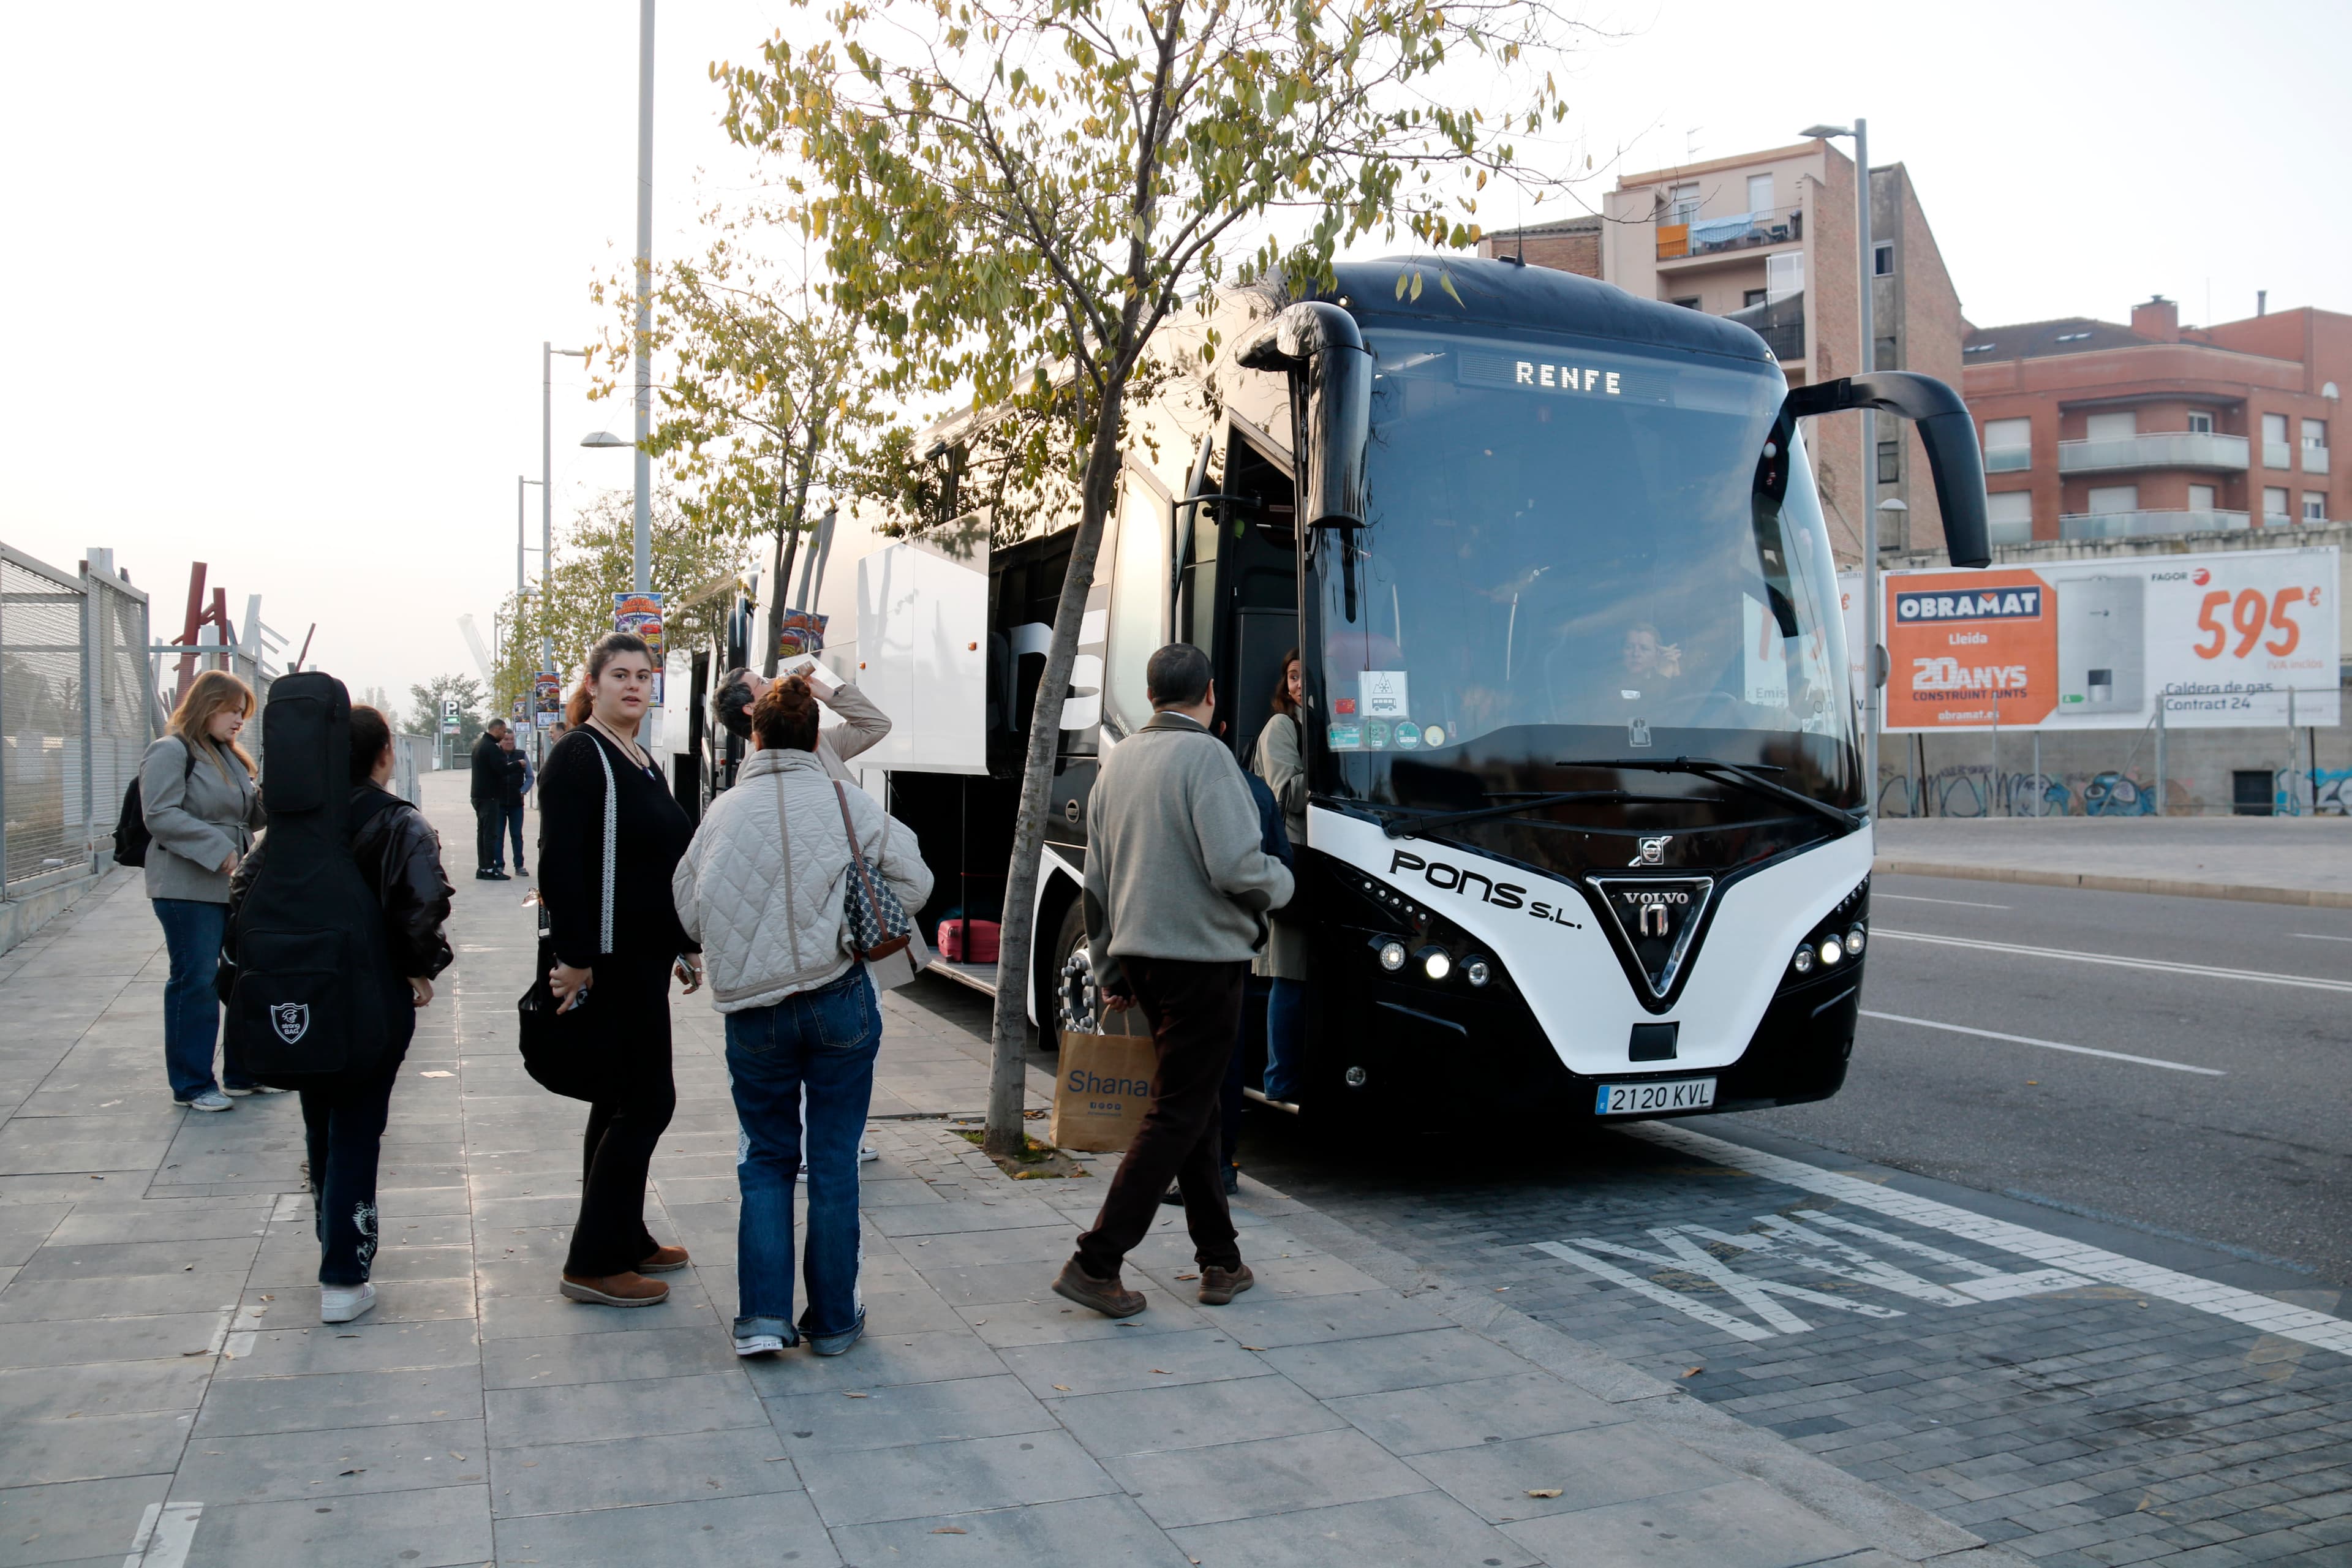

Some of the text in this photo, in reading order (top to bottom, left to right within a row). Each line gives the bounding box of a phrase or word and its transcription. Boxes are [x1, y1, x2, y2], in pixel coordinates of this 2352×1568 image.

[1517, 361, 1621, 394] RENFE
[2151, 572, 2188, 581] FAGOR
[1899, 592, 2037, 618] OBRAMAT
[1948, 632, 1988, 645] Lleida
[1912, 689, 1987, 701] CONSTRUINT
[2165, 680, 2273, 696] Caldera de gas
[2165, 697, 2250, 711] Contract 24
[1938, 709, 1999, 721] obramat.es
[1623, 892, 1689, 904] VOLVO
[1068, 1070, 1148, 1097] Shana
[1611, 1083, 1709, 1110] 2120 KVL
